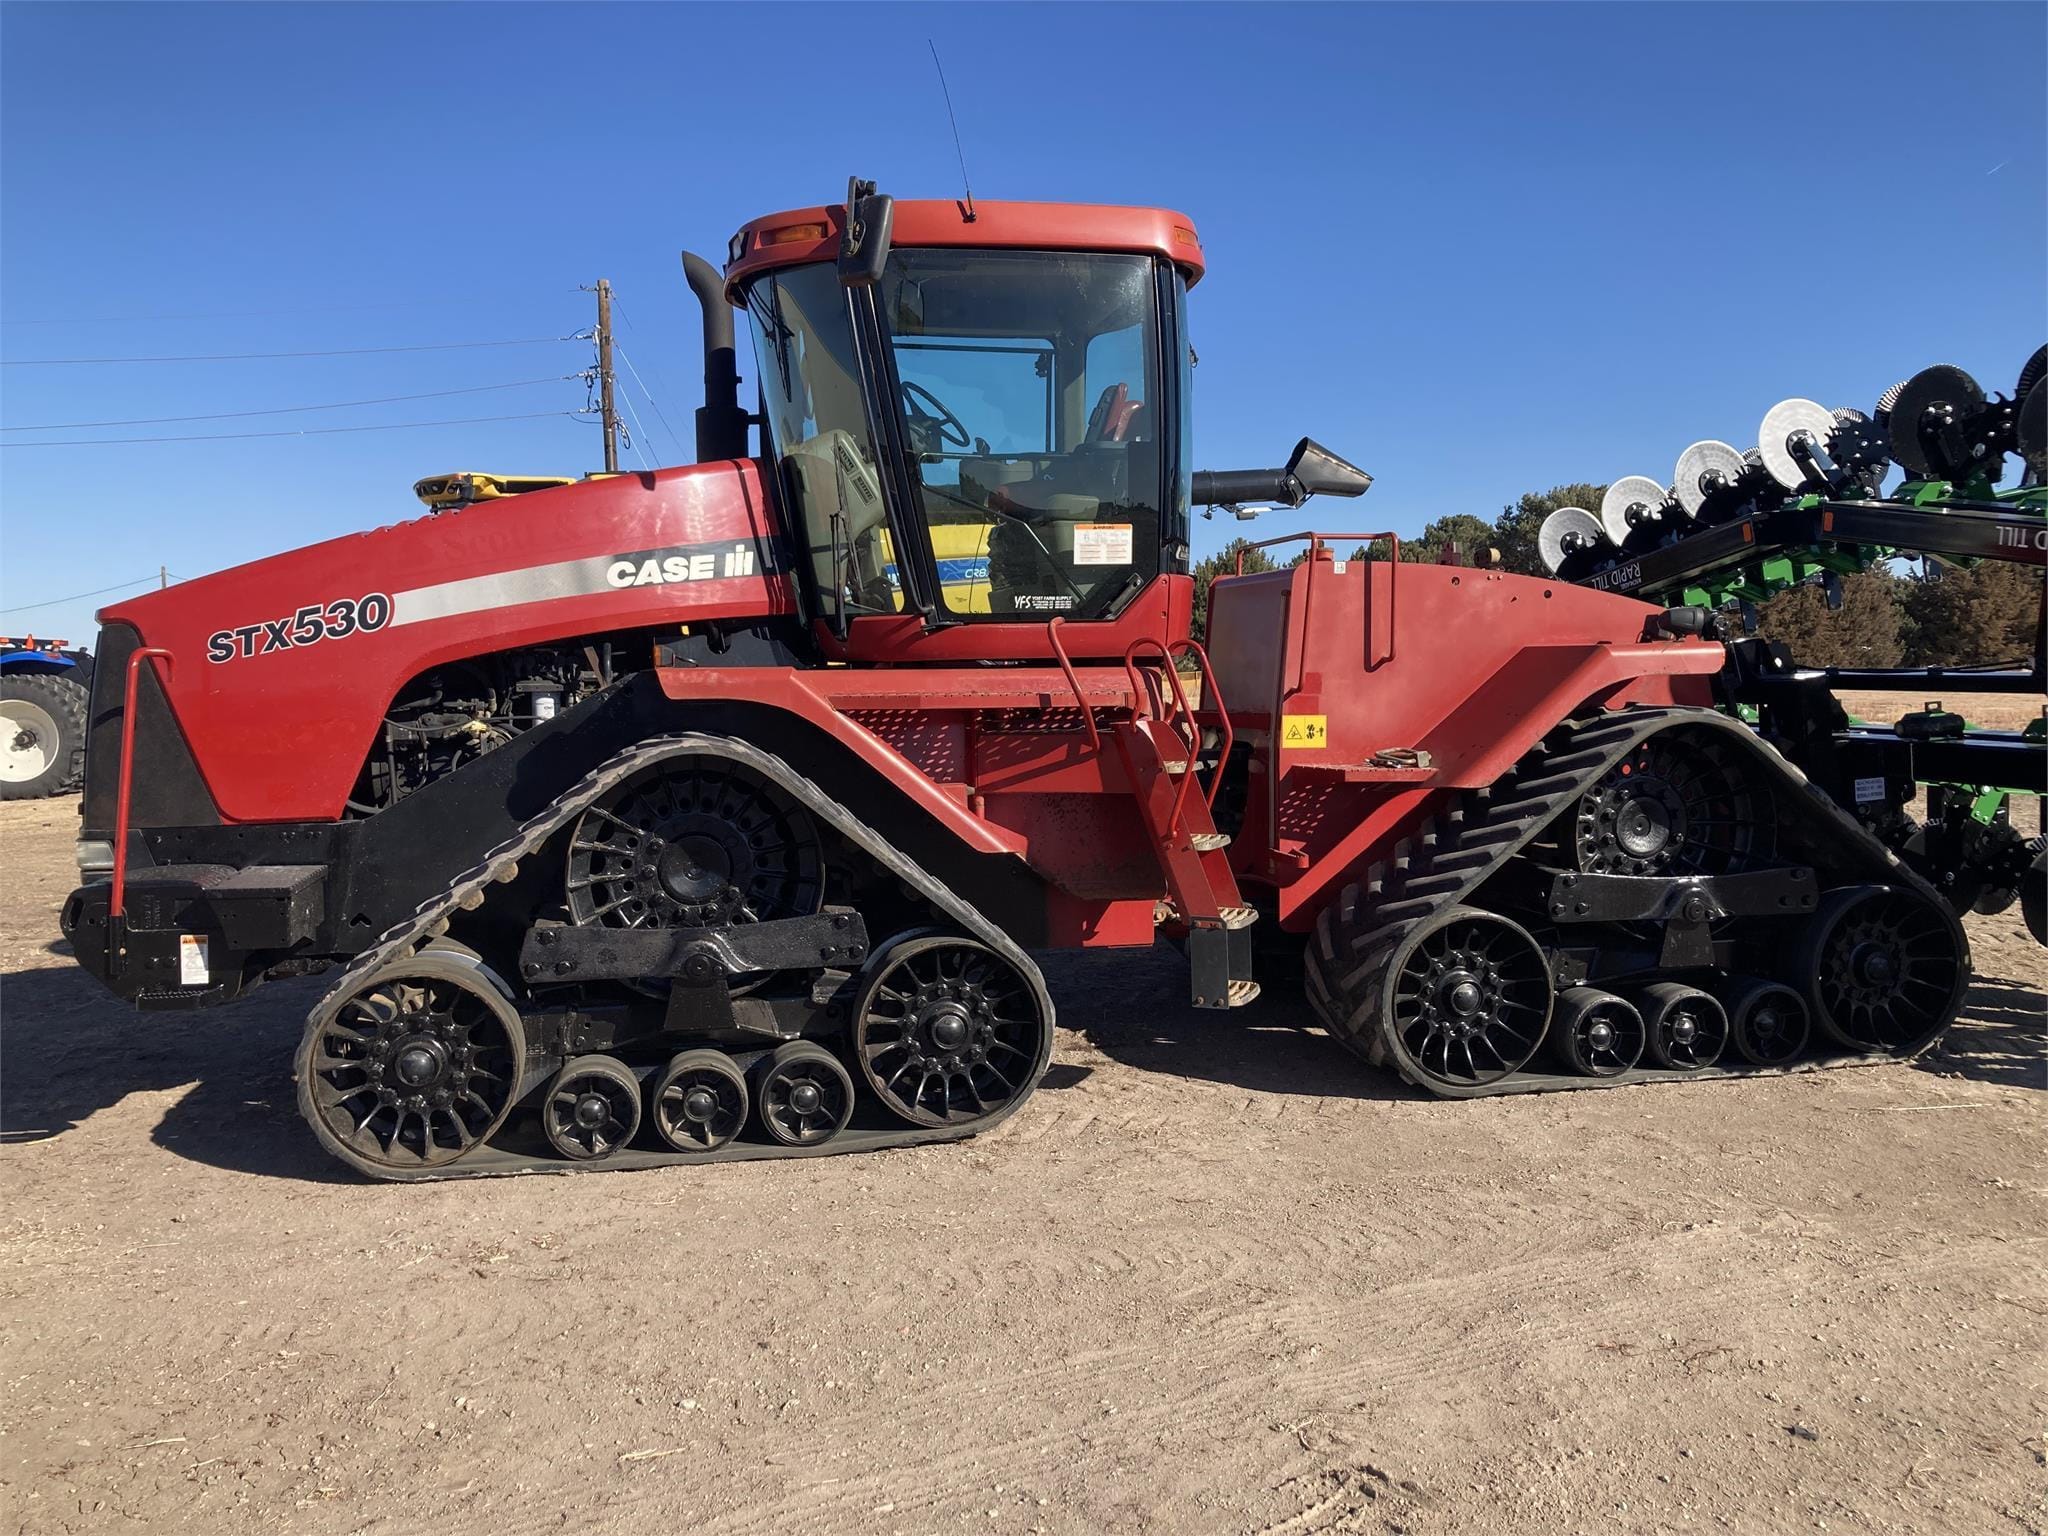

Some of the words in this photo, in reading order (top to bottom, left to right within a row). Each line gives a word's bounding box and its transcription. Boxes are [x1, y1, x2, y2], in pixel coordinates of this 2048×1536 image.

[1995, 525, 2029, 549] TILL
[606, 553, 715, 588] CASE
[1591, 574, 1610, 590] TILL
[1611, 562, 1641, 585] RAPID
[1014, 595, 1031, 609] YFS
[206, 592, 390, 664] STX530
